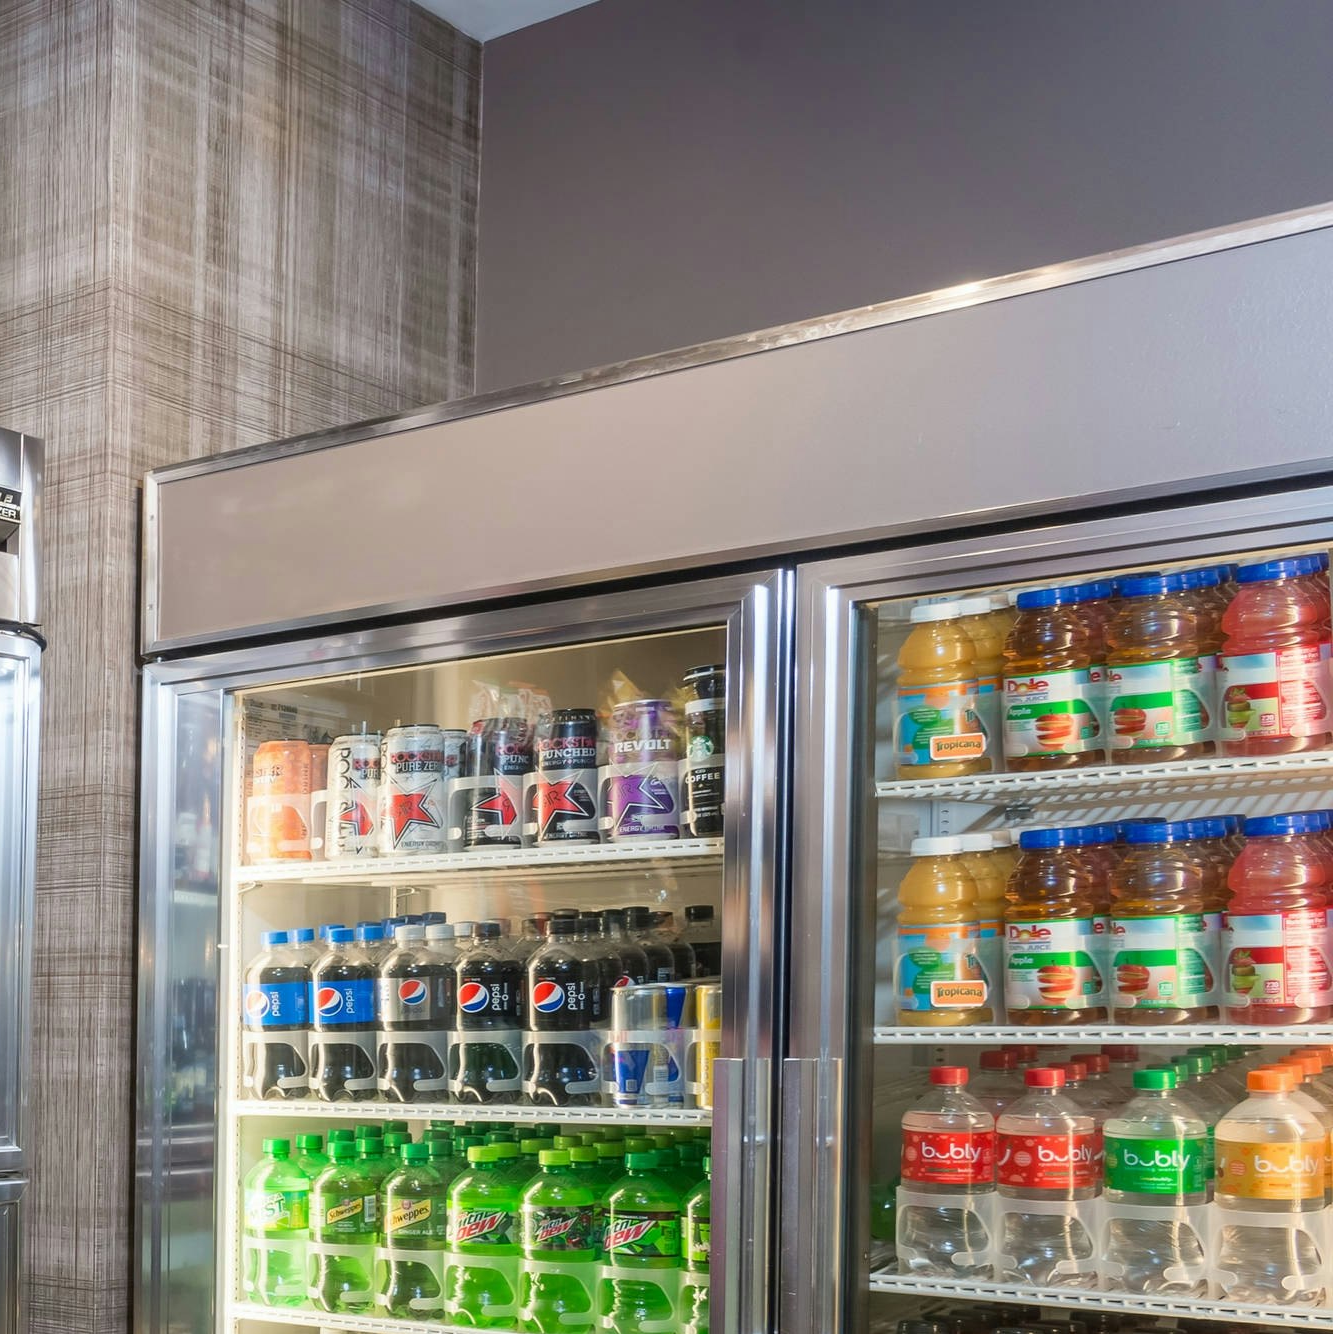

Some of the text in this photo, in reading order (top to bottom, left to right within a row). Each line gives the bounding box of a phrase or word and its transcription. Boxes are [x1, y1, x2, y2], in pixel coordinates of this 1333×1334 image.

[1007, 677, 1049, 693] Dole
[541, 748, 596, 758] PUNCHED
[615, 739, 671, 753] REVOLT
[935, 740, 982, 754] Tropicana
[1008, 924, 1051, 940] Dole
[345, 987, 354, 1014] pepsi
[491, 982, 500, 1011] pepsi
[567, 982, 576, 1010] pepsi
[935, 986, 983, 998] Tropicana
[271, 990, 280, 1017] pepsi
[920, 1142, 982, 1162] bubly
[1037, 1145, 1093, 1163] bubly
[1123, 1148, 1190, 1170] bubly
[1254, 1155, 1319, 1175] bubly
